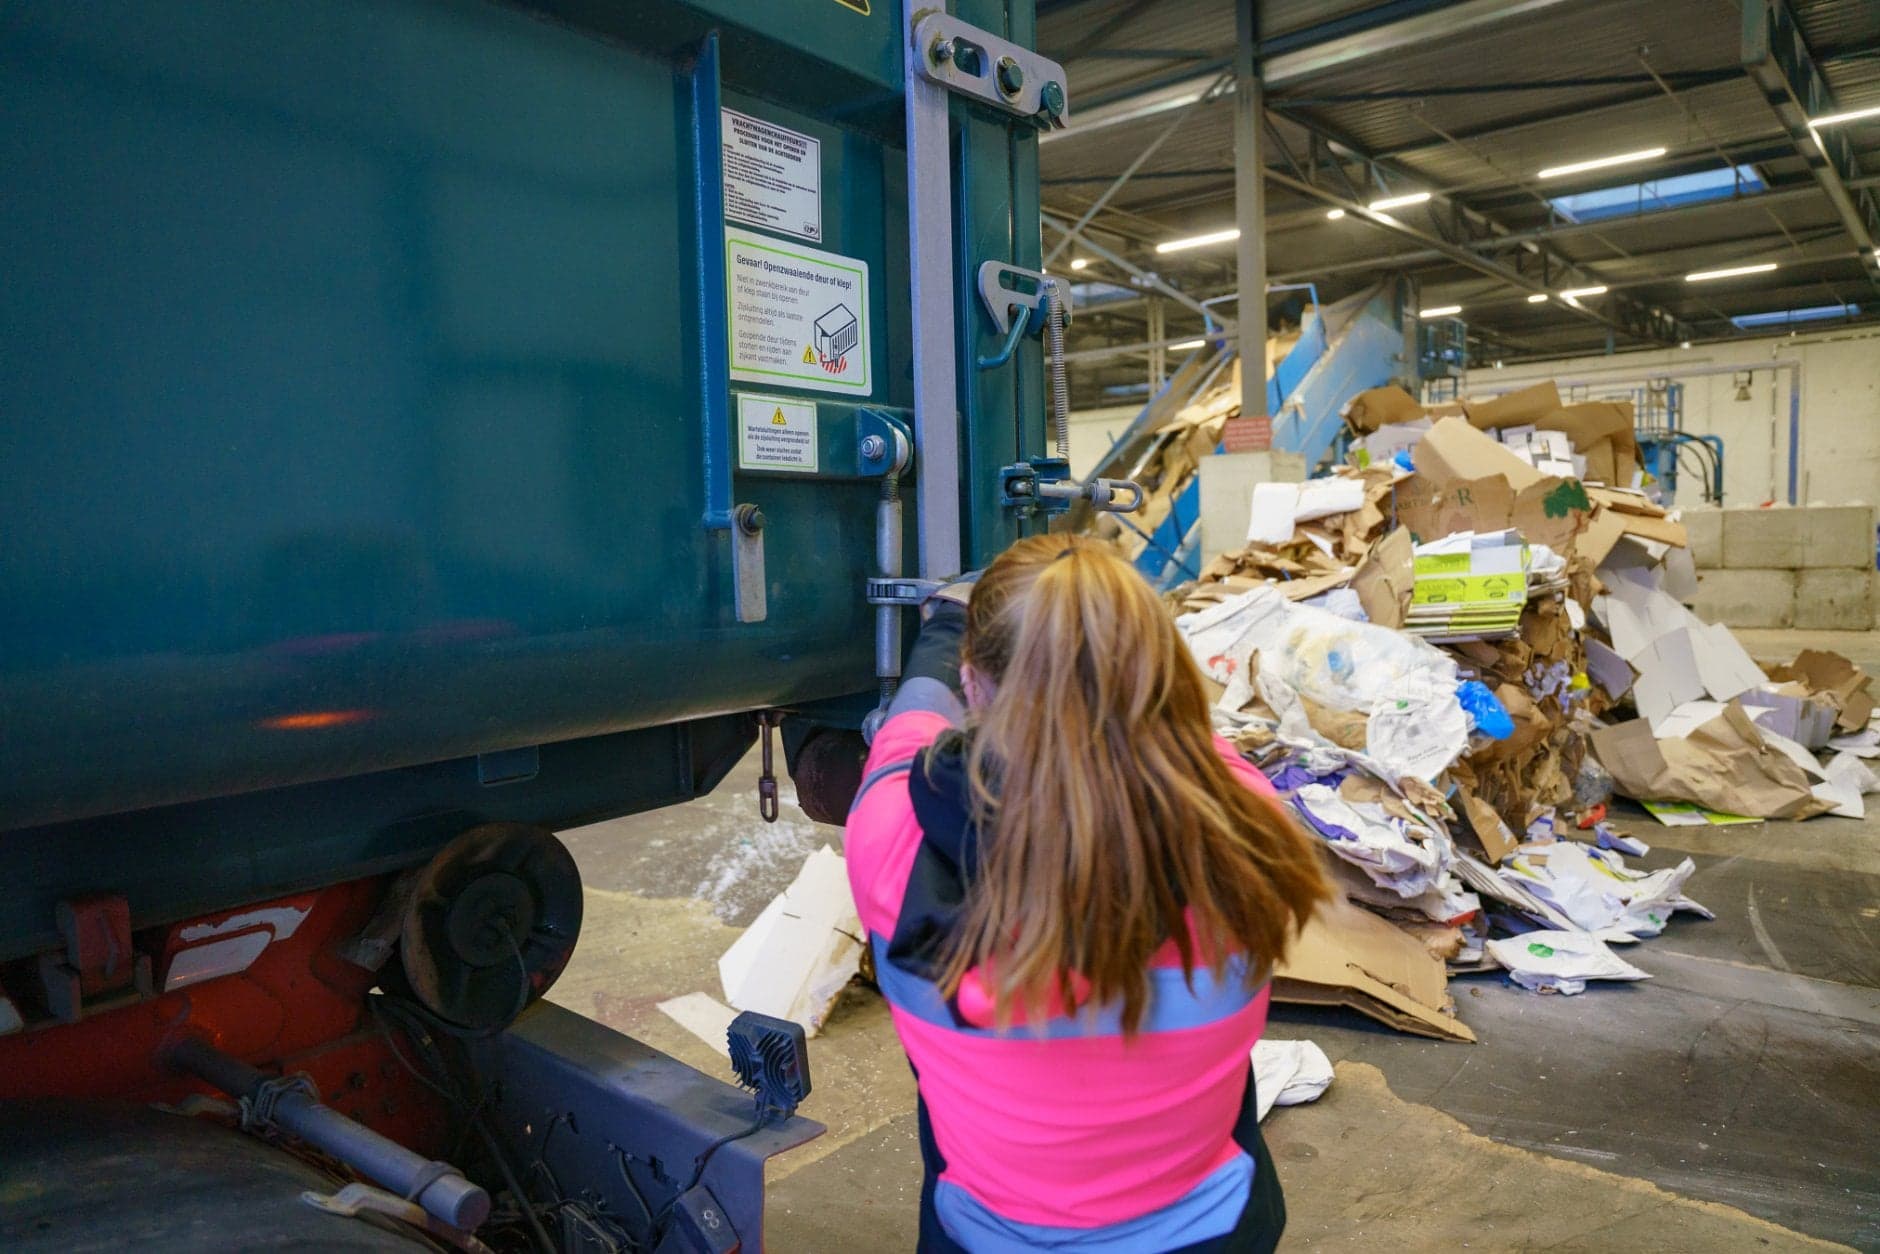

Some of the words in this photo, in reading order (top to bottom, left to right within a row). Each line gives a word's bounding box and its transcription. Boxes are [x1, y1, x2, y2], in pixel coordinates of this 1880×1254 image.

[736, 254, 763, 269] Gevaar!
[763, 260, 814, 281] Openzwaaiende
[814, 273, 829, 285] deur
[829, 276, 836, 286] of
[836, 278, 852, 290] klep!
[736, 274, 749, 283] Niet
[743, 286, 756, 297] klep
